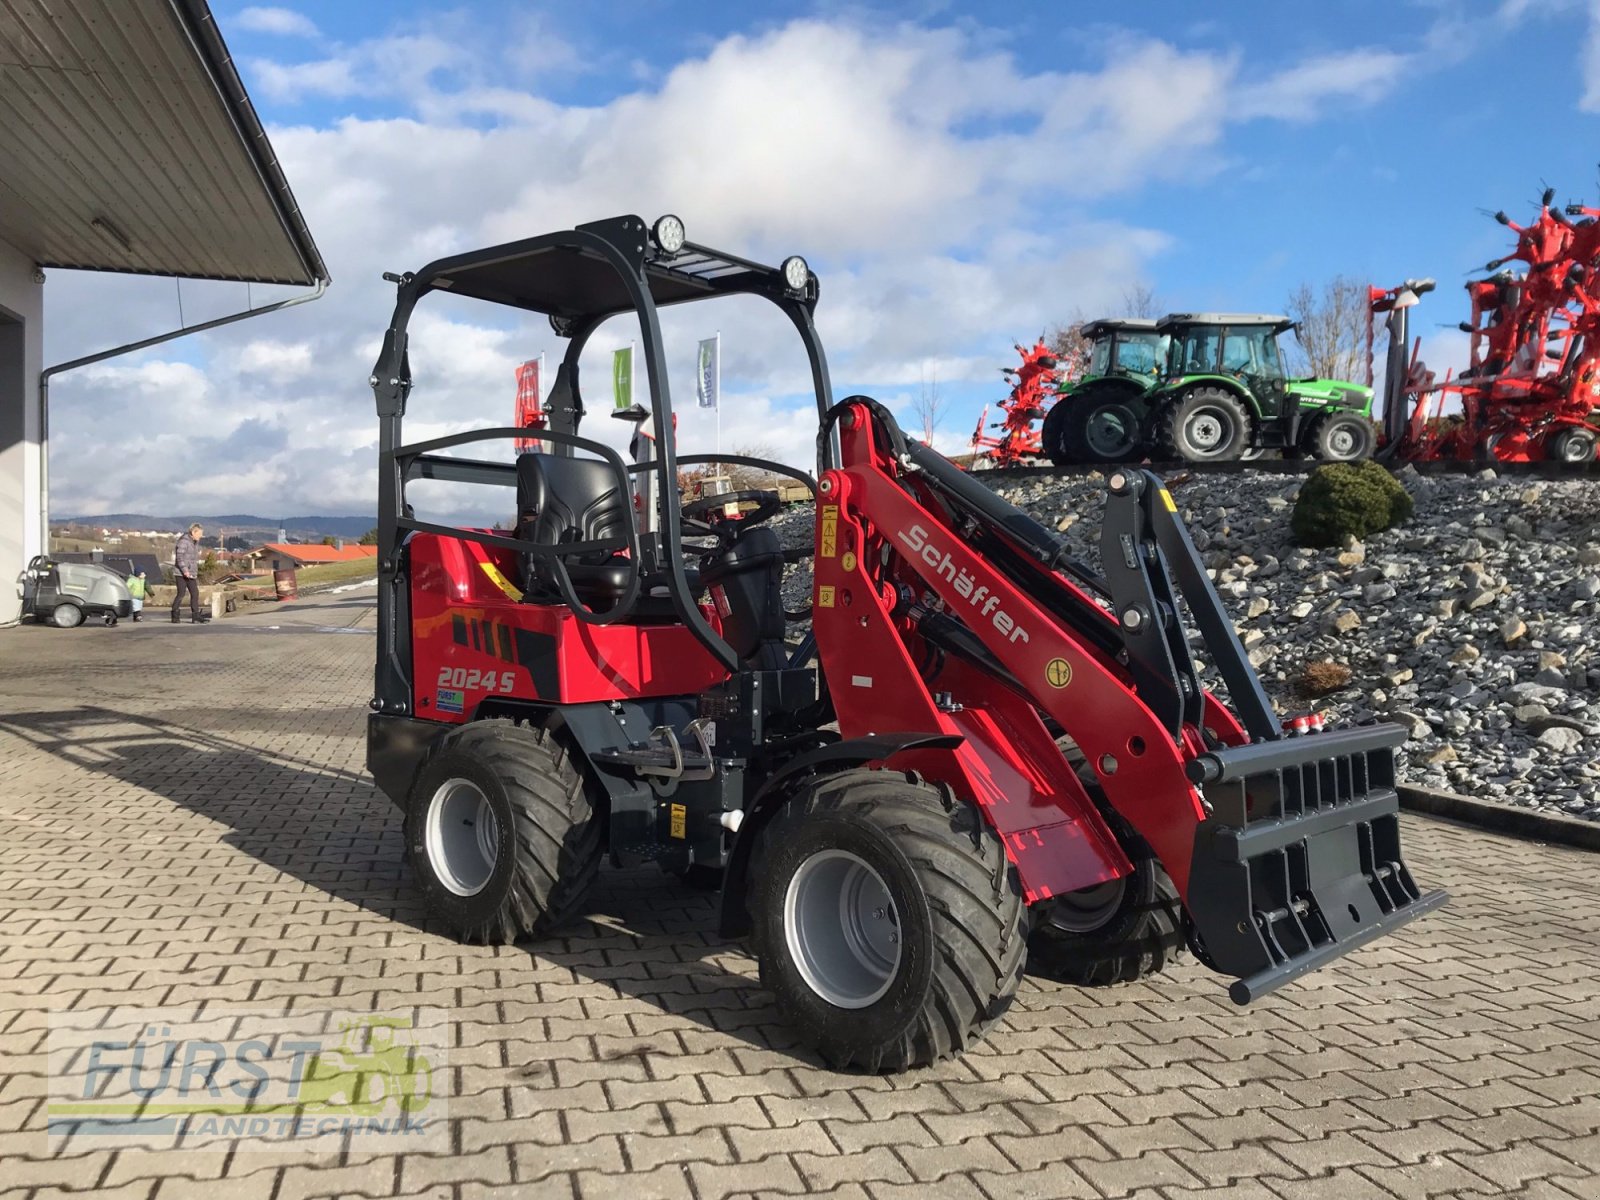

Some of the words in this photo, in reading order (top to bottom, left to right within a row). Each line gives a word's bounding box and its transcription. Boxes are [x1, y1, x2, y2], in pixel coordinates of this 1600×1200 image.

[898, 524, 1030, 644] Schäffer
[437, 666, 497, 692] 2024
[499, 672, 516, 693] S
